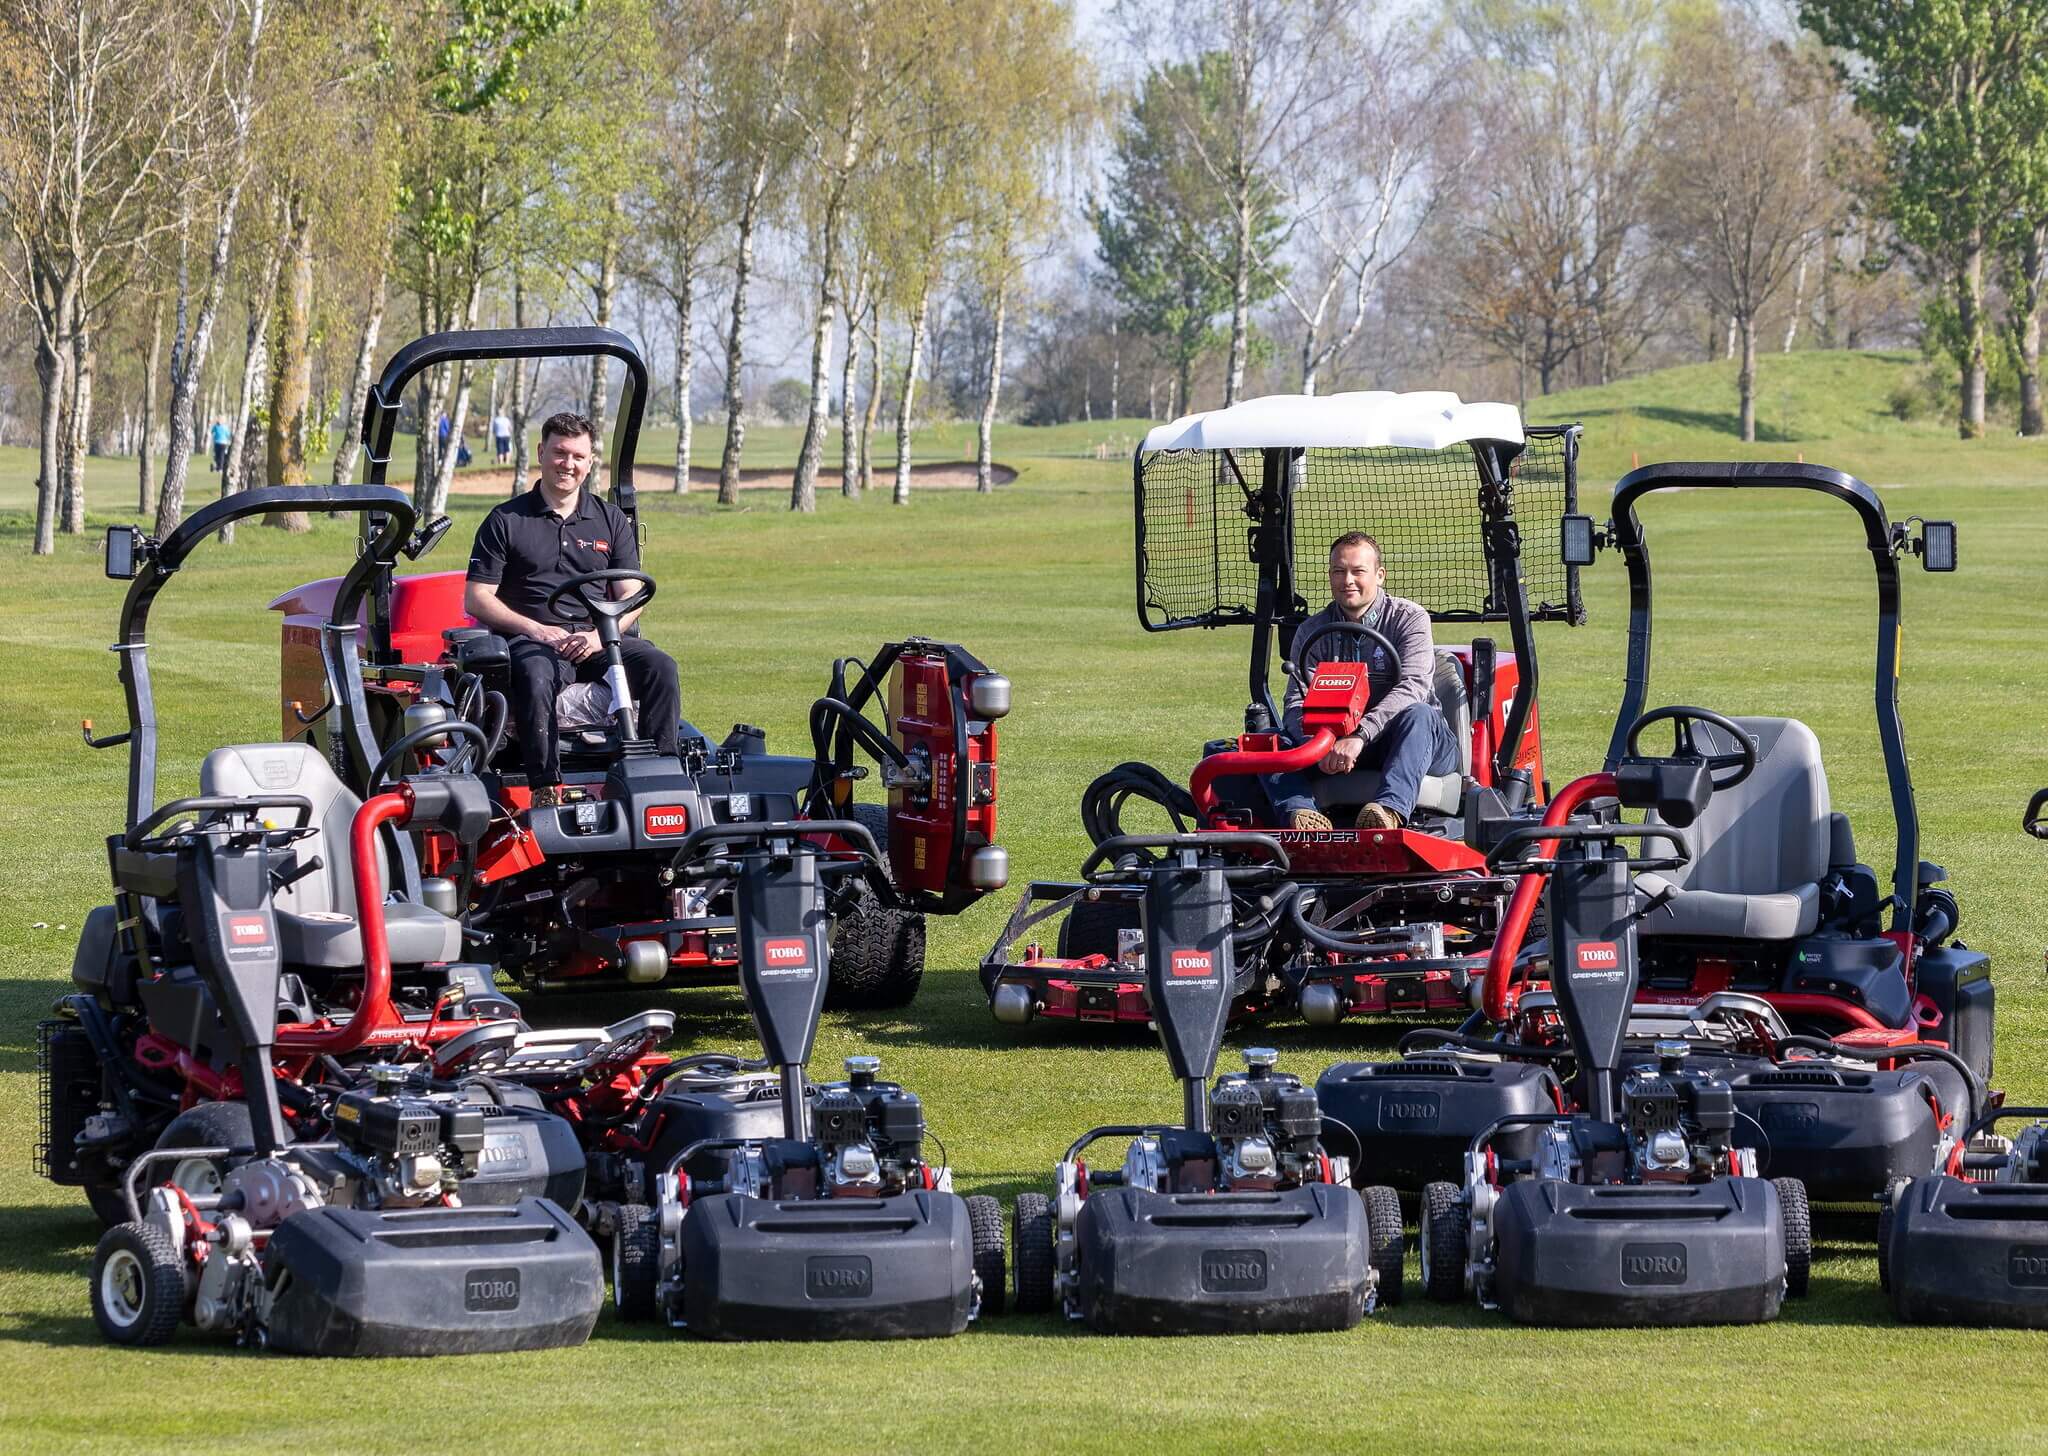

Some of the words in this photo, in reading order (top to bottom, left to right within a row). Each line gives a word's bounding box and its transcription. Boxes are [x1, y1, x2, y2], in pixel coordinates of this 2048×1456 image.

[649, 815, 684, 827] TORO
[1269, 832, 1360, 843] EWINDER
[233, 925, 264, 936] TORO
[769, 947, 803, 958] TORO
[1580, 950, 1614, 961] TORO
[1175, 958, 1209, 968] TORO
[760, 968, 813, 976] GREENSMASTER
[1572, 971, 1624, 979] GREENSMASTER
[1384, 1104, 1436, 1118] TORO
[1626, 1256, 1682, 1273] TORO
[2012, 1257, 2048, 1275] TOR
[1206, 1263, 1263, 1280] TORO
[808, 1270, 866, 1287] TORO
[469, 1281, 516, 1300] TORO
